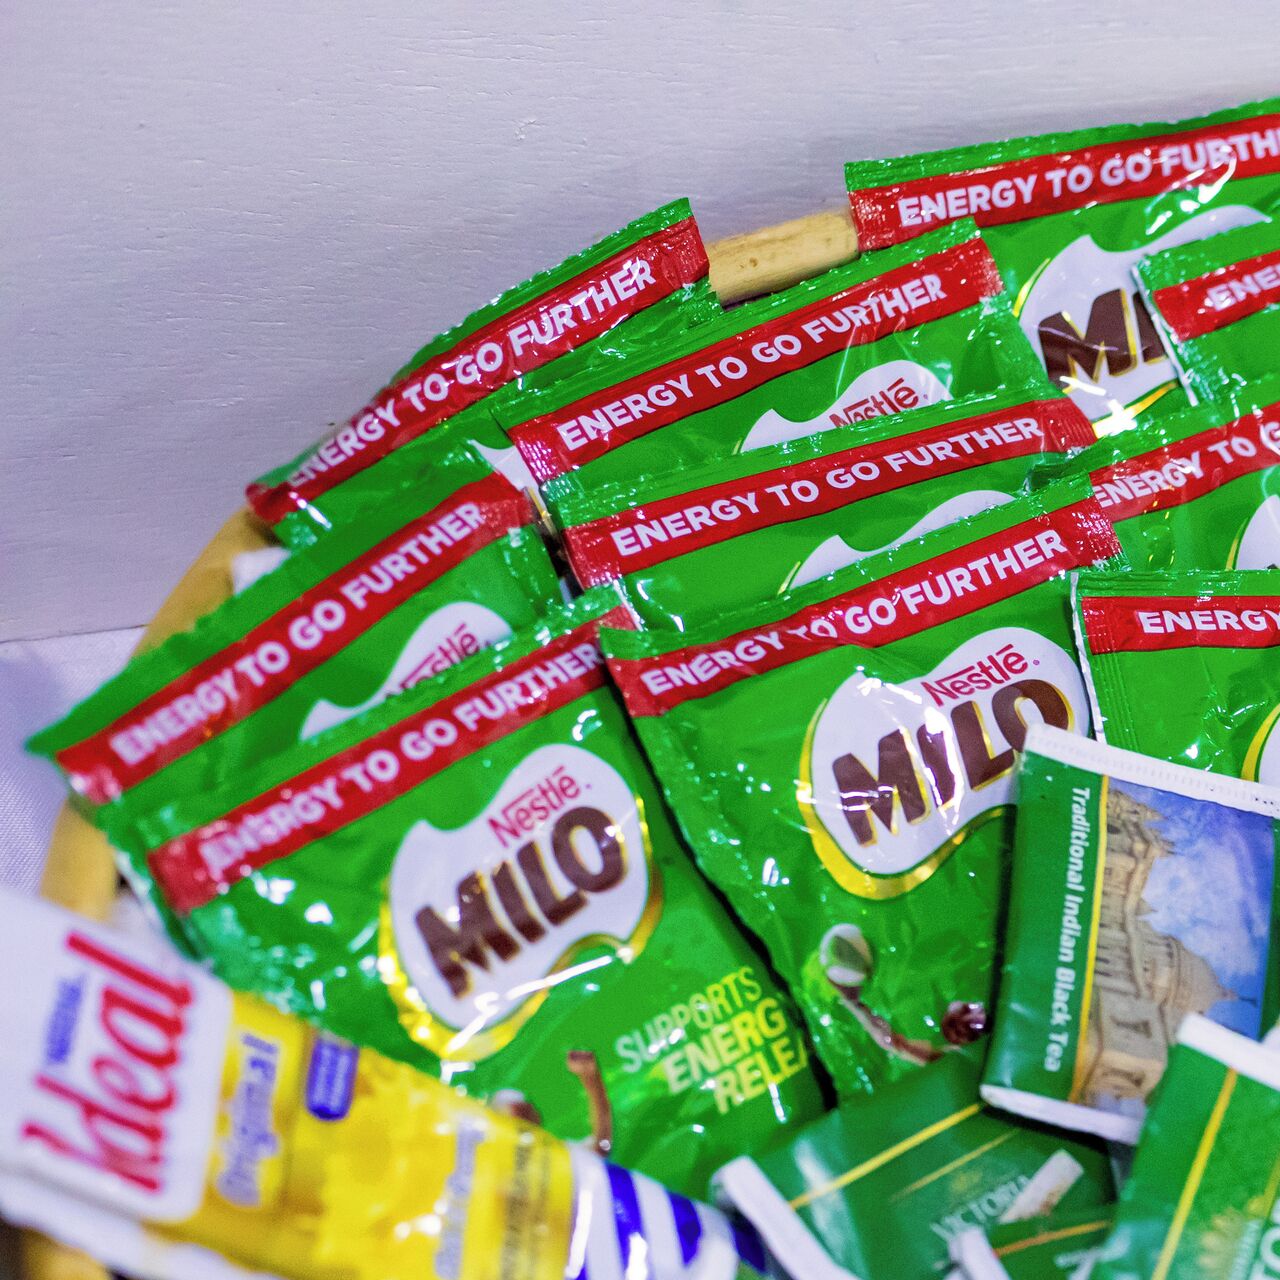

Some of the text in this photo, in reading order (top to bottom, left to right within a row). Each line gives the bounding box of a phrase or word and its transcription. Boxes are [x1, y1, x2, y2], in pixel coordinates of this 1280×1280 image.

[898, 173, 1038, 227] ENERGY
[1046, 166, 1094, 198] TO
[1101, 152, 1154, 184] GO
[403, 374, 450, 412] TO
[455, 342, 503, 385] GO
[508, 259, 657, 357] FURTHER
[557, 275, 947, 453] ENERGY TO GO FURTHER
[612, 416, 1046, 558] ENERGY TO GO FURTHER
[1094, 450, 1205, 511] ENERGY
[1208, 436, 1257, 465] TO
[109, 501, 487, 765] ENERGY TO GO FURTHER
[639, 527, 1068, 697] ENERGY GO FURTHER
[920, 643, 1030, 709] Nestlé
[198, 787, 345, 868] ENERGY
[347, 750, 399, 790] TO
[402, 718, 459, 761] GO
[453, 646, 603, 730] FURTHER
[487, 766, 583, 849] Nestlé
[831, 679, 1069, 850] MILO
[414, 805, 627, 1000] MILO
[1043, 787, 1091, 1074] Traditional Indian Black Tea
[16, 930, 195, 1195] Ideal
[615, 965, 766, 1078] SUPPORTS
